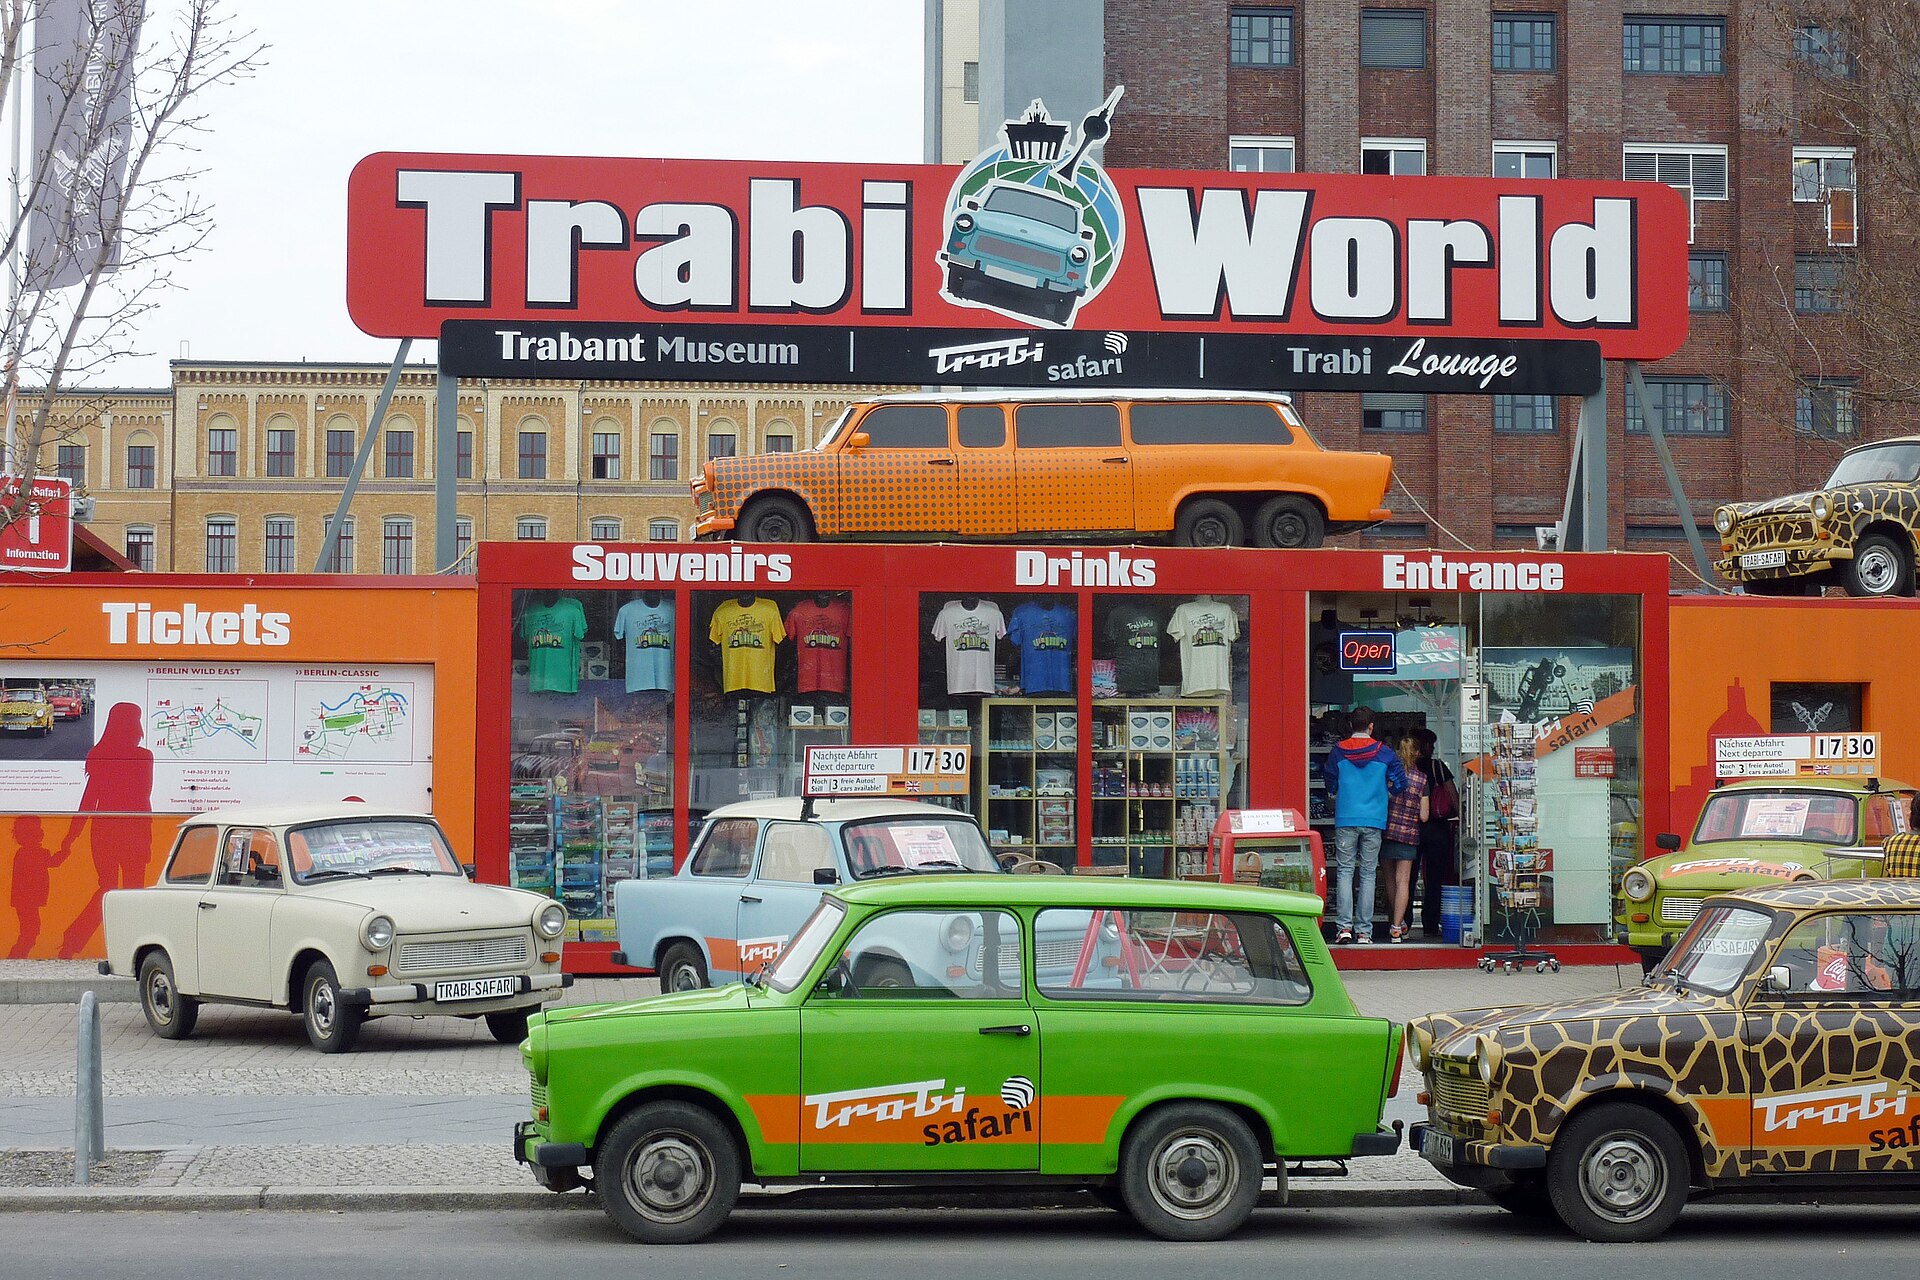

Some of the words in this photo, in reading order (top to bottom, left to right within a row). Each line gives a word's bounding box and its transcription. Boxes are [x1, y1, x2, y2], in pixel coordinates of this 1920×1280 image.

[396, 170, 912, 315] Trabi
[1136, 186, 1638, 328] World
[495, 330, 646, 363] Trabant
[657, 336, 799, 365] Museum
[1047, 353, 1123, 382] safari
[1287, 347, 1372, 374] Trabi
[1388, 338, 1518, 388] Lounge
[6, 548, 60, 560] Information
[572, 545, 793, 582] Souvenirs
[1743, 551, 1785, 567] TRABI-SAFARI
[1015, 550, 1157, 587] Drinks
[1382, 554, 1564, 591] Entrance
[102, 603, 291, 646] Tickets
[1344, 641, 1391, 665] Open
[156, 667, 189, 675] BERLIN
[304, 669, 380, 677] BERLIN-CLASSIC
[1549, 717, 1598, 751] safari
[1753, 739, 1785, 748] Abfahrt
[847, 750, 878, 760] Abfahrt
[1719, 749, 1740, 758] Next
[1742, 749, 1783, 759] departure
[1819, 738, 1874, 756] 17:30
[812, 762, 833, 771] Next
[835, 762, 876, 773] departure
[912, 751, 966, 771] 17:30
[1738, 764, 1745, 774] 3
[832, 779, 839, 790] 3
[854, 784, 882, 792] available!
[1728, 865, 1792, 878] safari
[436, 977, 514, 1001] TRABI-SAFARI
[805, 1079, 965, 1131] Trabi
[1753, 1082, 1908, 1132] Trabi
[923, 1107, 1033, 1147] safari
[1868, 1119, 1920, 1152] saf
